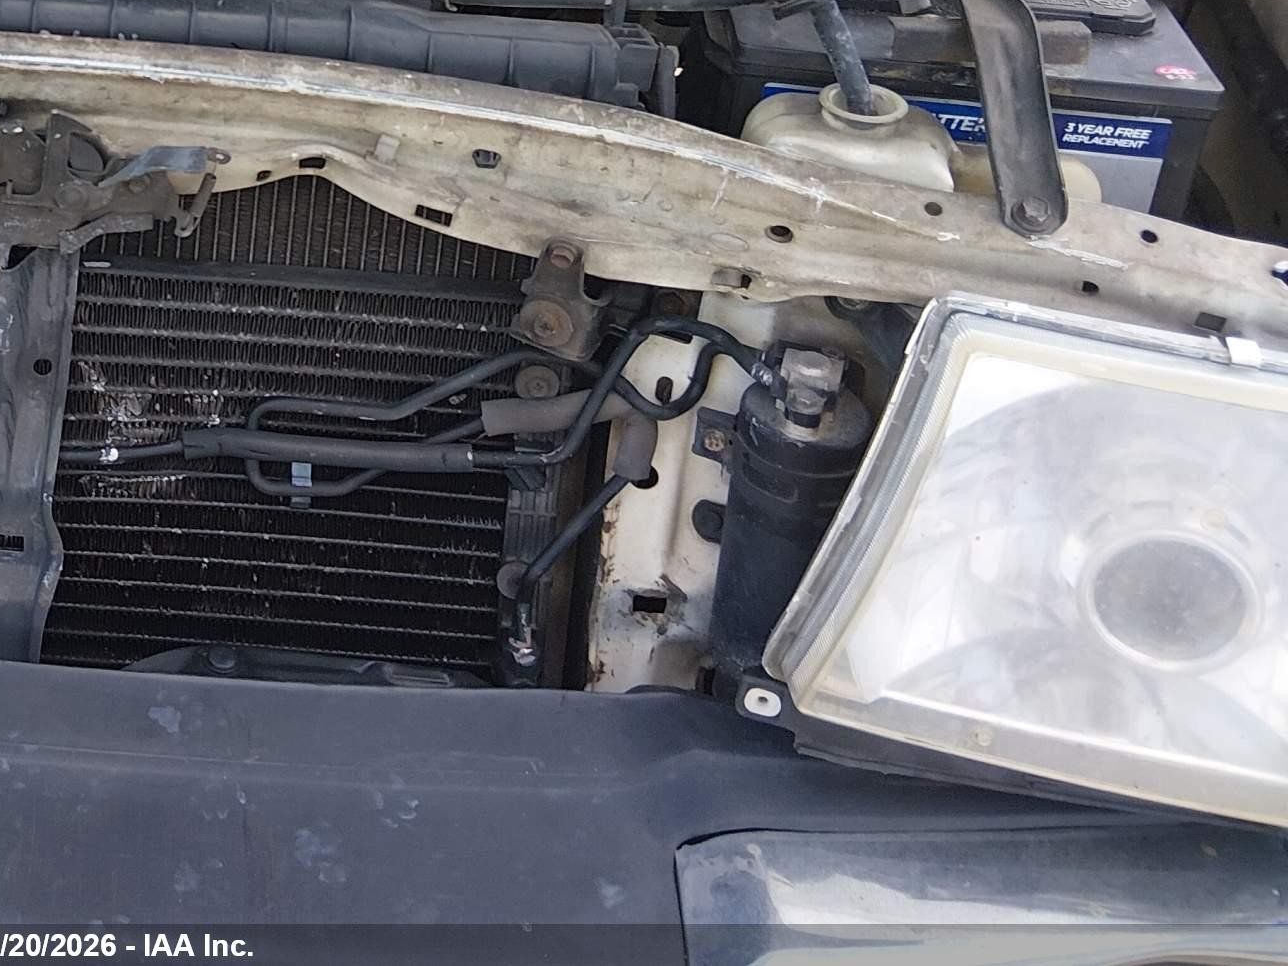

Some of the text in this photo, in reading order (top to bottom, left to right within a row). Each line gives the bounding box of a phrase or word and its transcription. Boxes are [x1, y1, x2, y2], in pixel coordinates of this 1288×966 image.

[932, 113, 986, 132] TTER
[1064, 122, 1153, 140] 3 YEAR FREE
